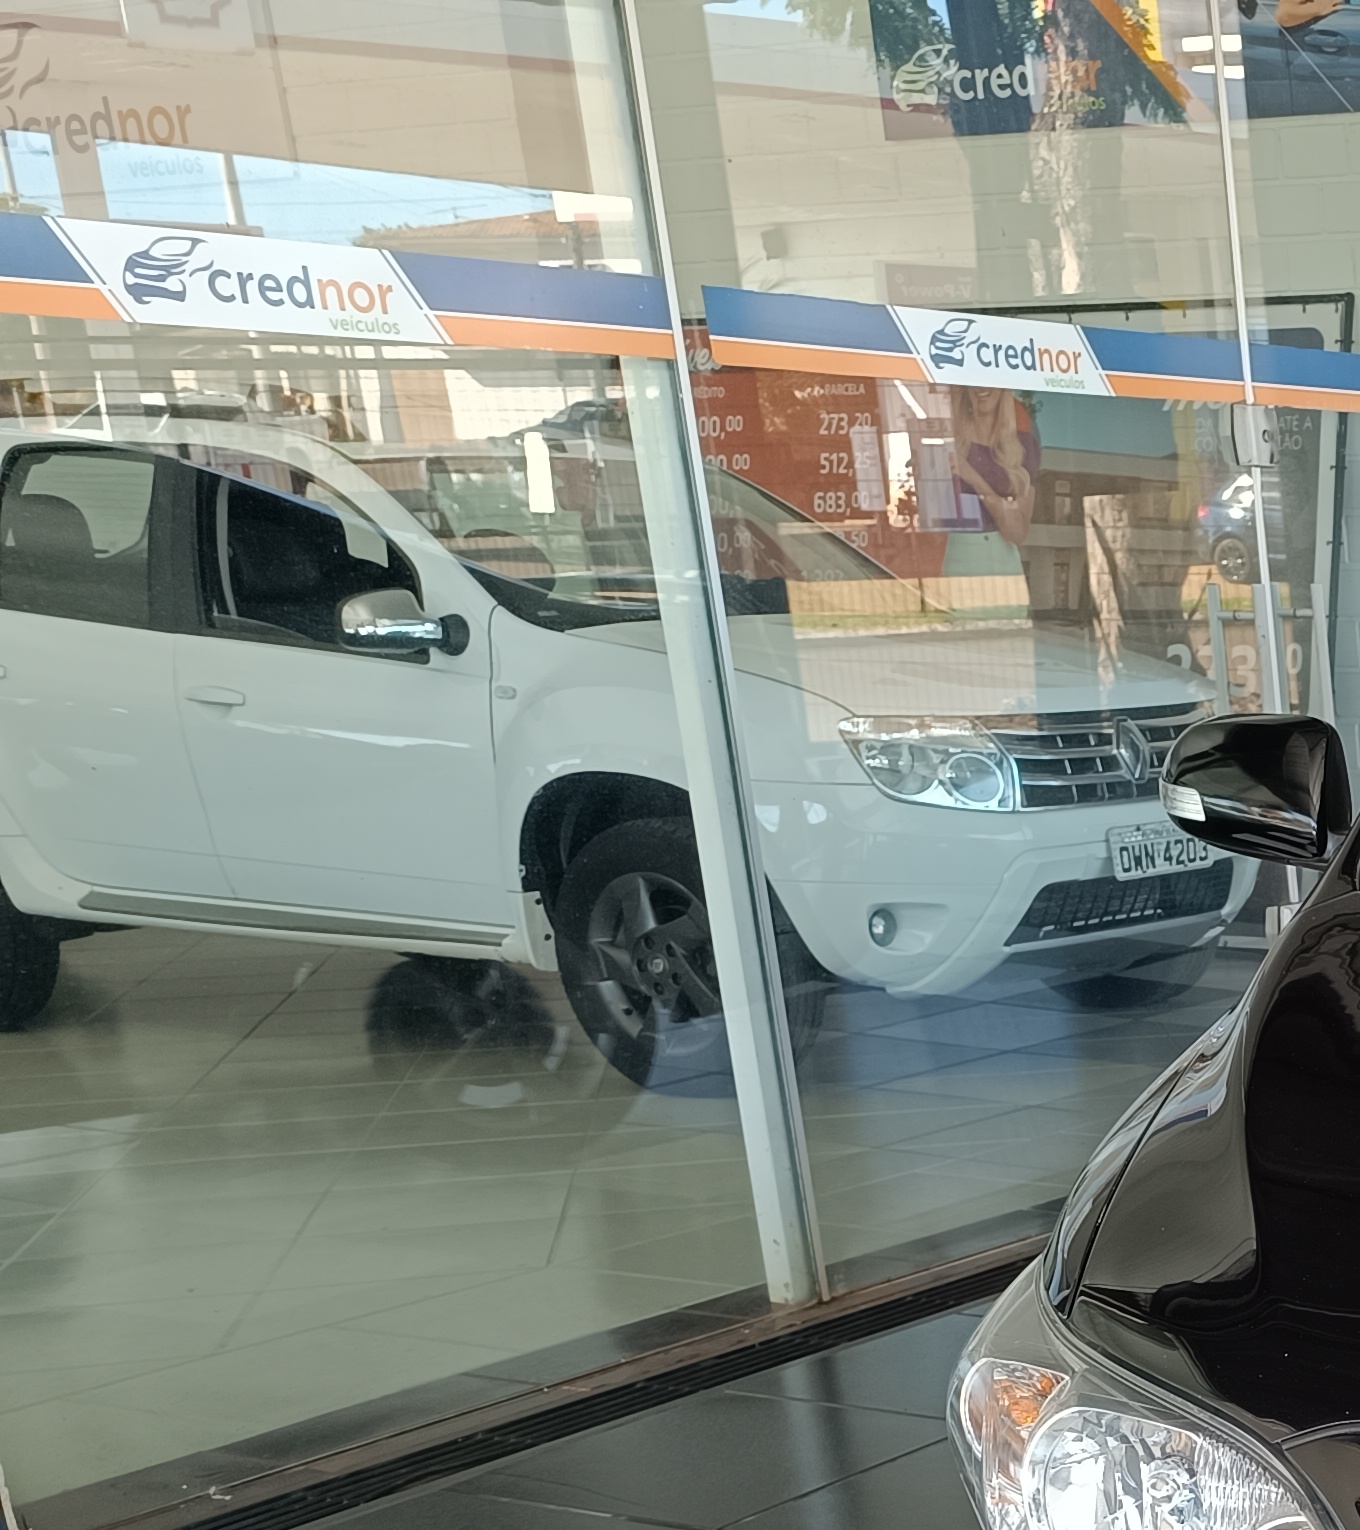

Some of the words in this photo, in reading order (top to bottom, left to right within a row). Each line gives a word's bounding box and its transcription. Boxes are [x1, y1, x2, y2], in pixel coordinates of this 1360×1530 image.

[21, 95, 192, 155] crednor
[207, 265, 393, 315] crednor
[976, 338, 1082, 374] crednor
[824, 383, 867, 396] PARCELA
